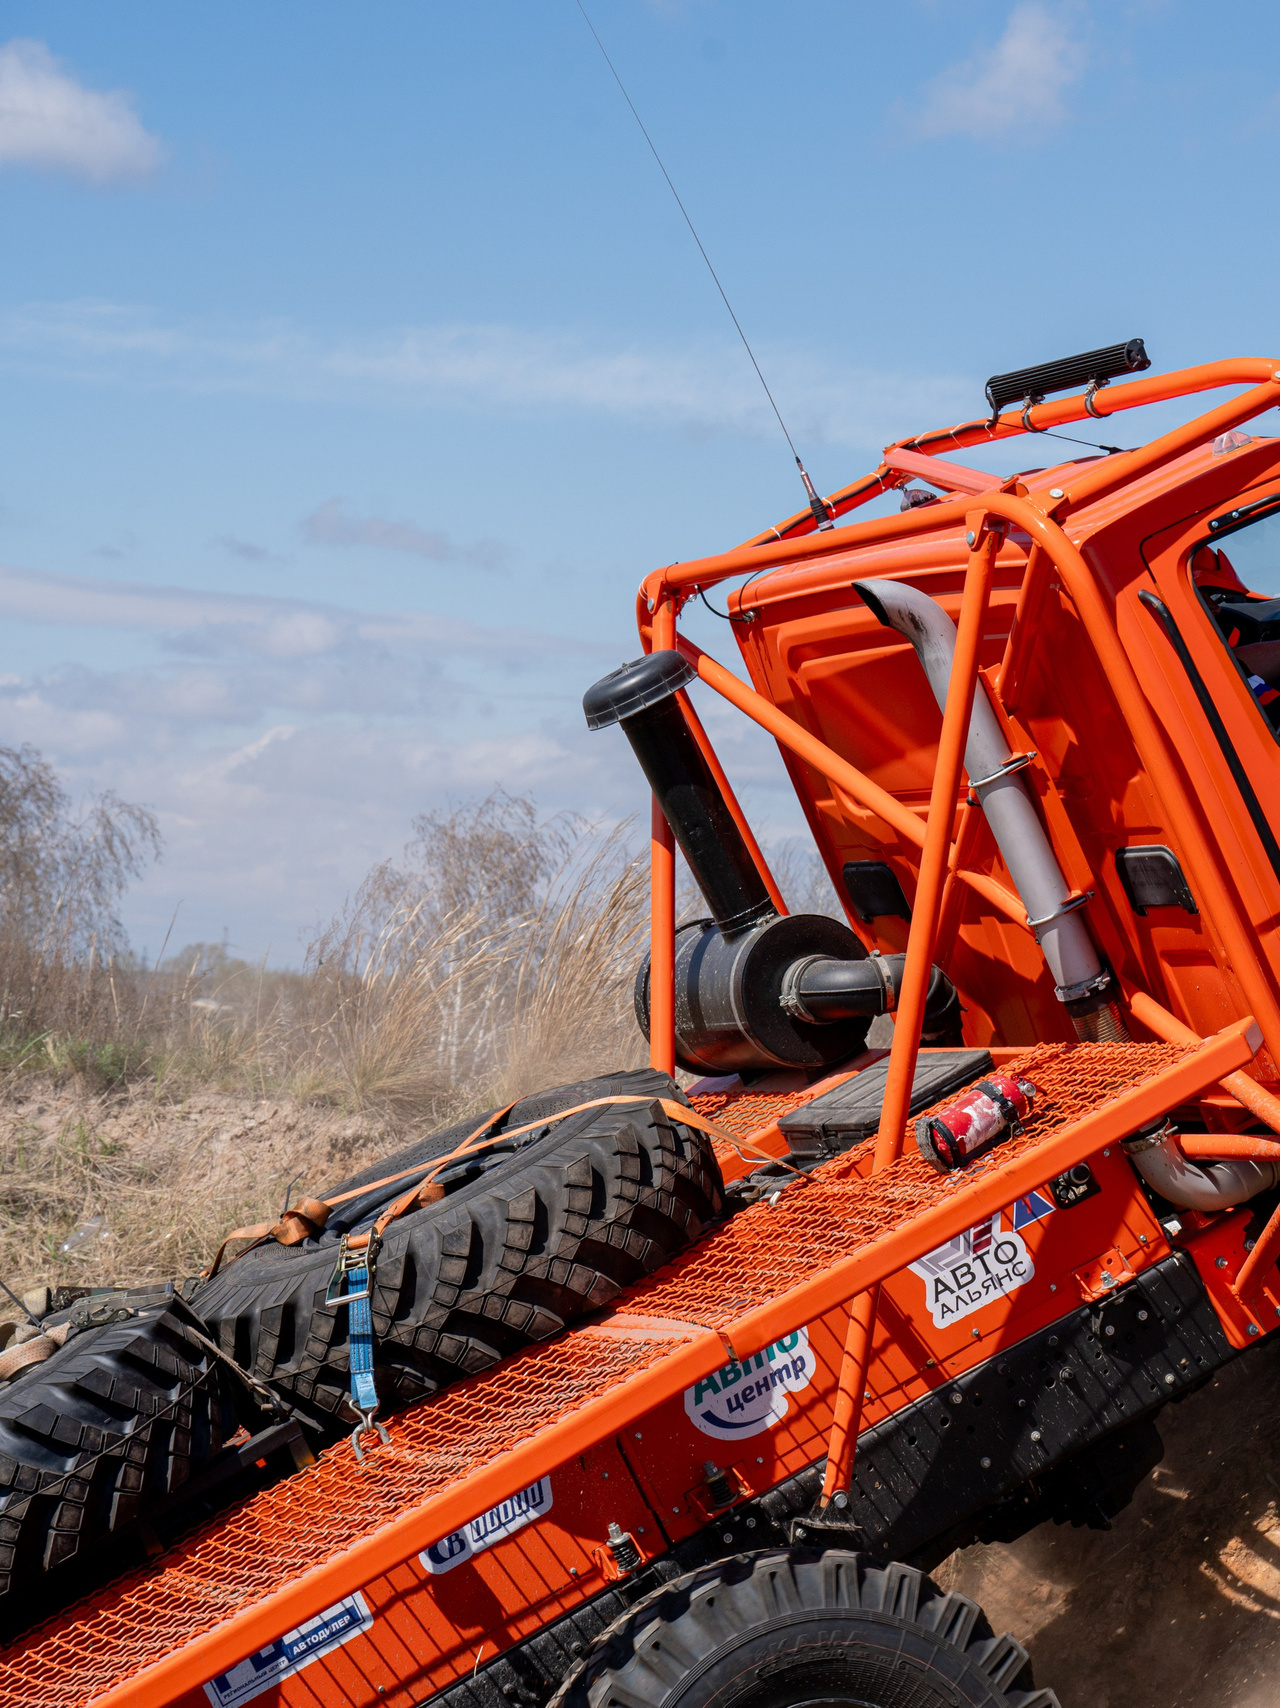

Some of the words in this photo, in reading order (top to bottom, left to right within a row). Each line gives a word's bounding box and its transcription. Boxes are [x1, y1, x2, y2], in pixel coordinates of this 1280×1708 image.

[934, 1240, 1019, 1304] АВТО
[940, 1260, 1027, 1319] АЛЬЯНС
[725, 1355, 807, 1414] центр
[292, 1614, 351, 1656] АВТОДИЛЕР
[223, 1670, 268, 1700] РЕГИОНАЛЬНЫЙ
[268, 1659, 287, 1675] ЦЕНТР
